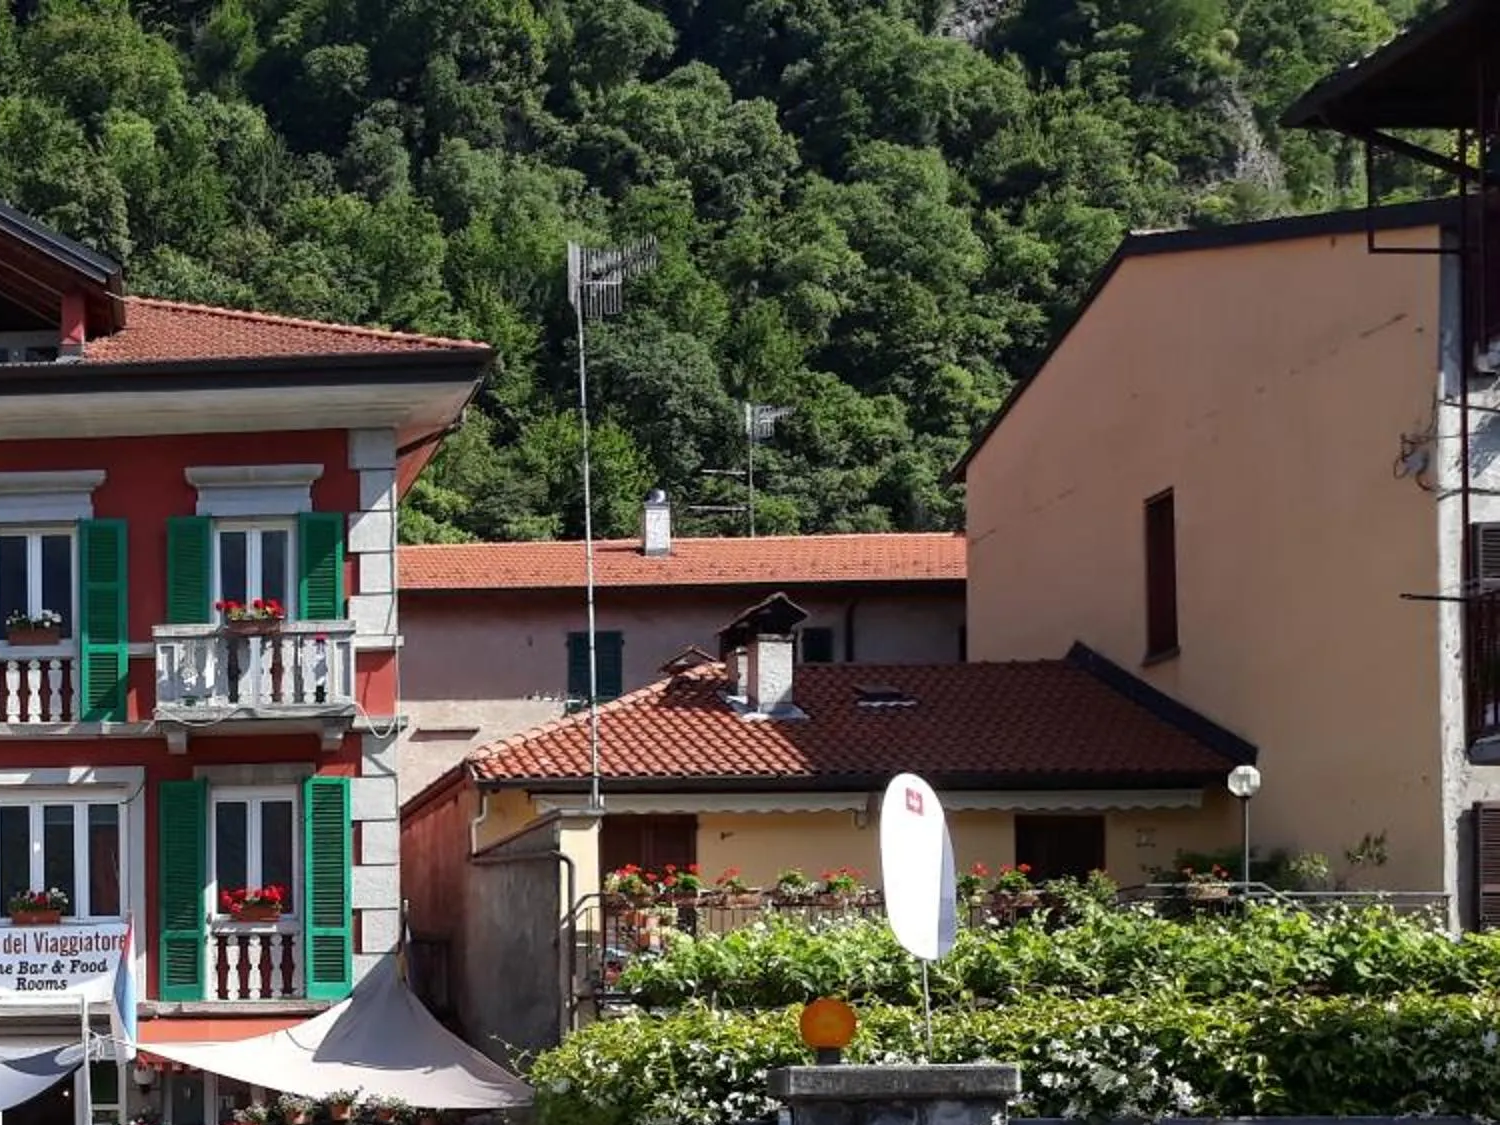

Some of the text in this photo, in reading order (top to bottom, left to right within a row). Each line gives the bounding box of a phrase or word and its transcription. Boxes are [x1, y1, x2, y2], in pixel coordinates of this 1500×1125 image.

[3, 934, 28, 955] del
[34, 931, 127, 957] Viaggiatore
[18, 960, 47, 975] Bar
[51, 960, 65, 974] &
[70, 959, 109, 974] Food
[15, 978, 68, 992] Rooms
